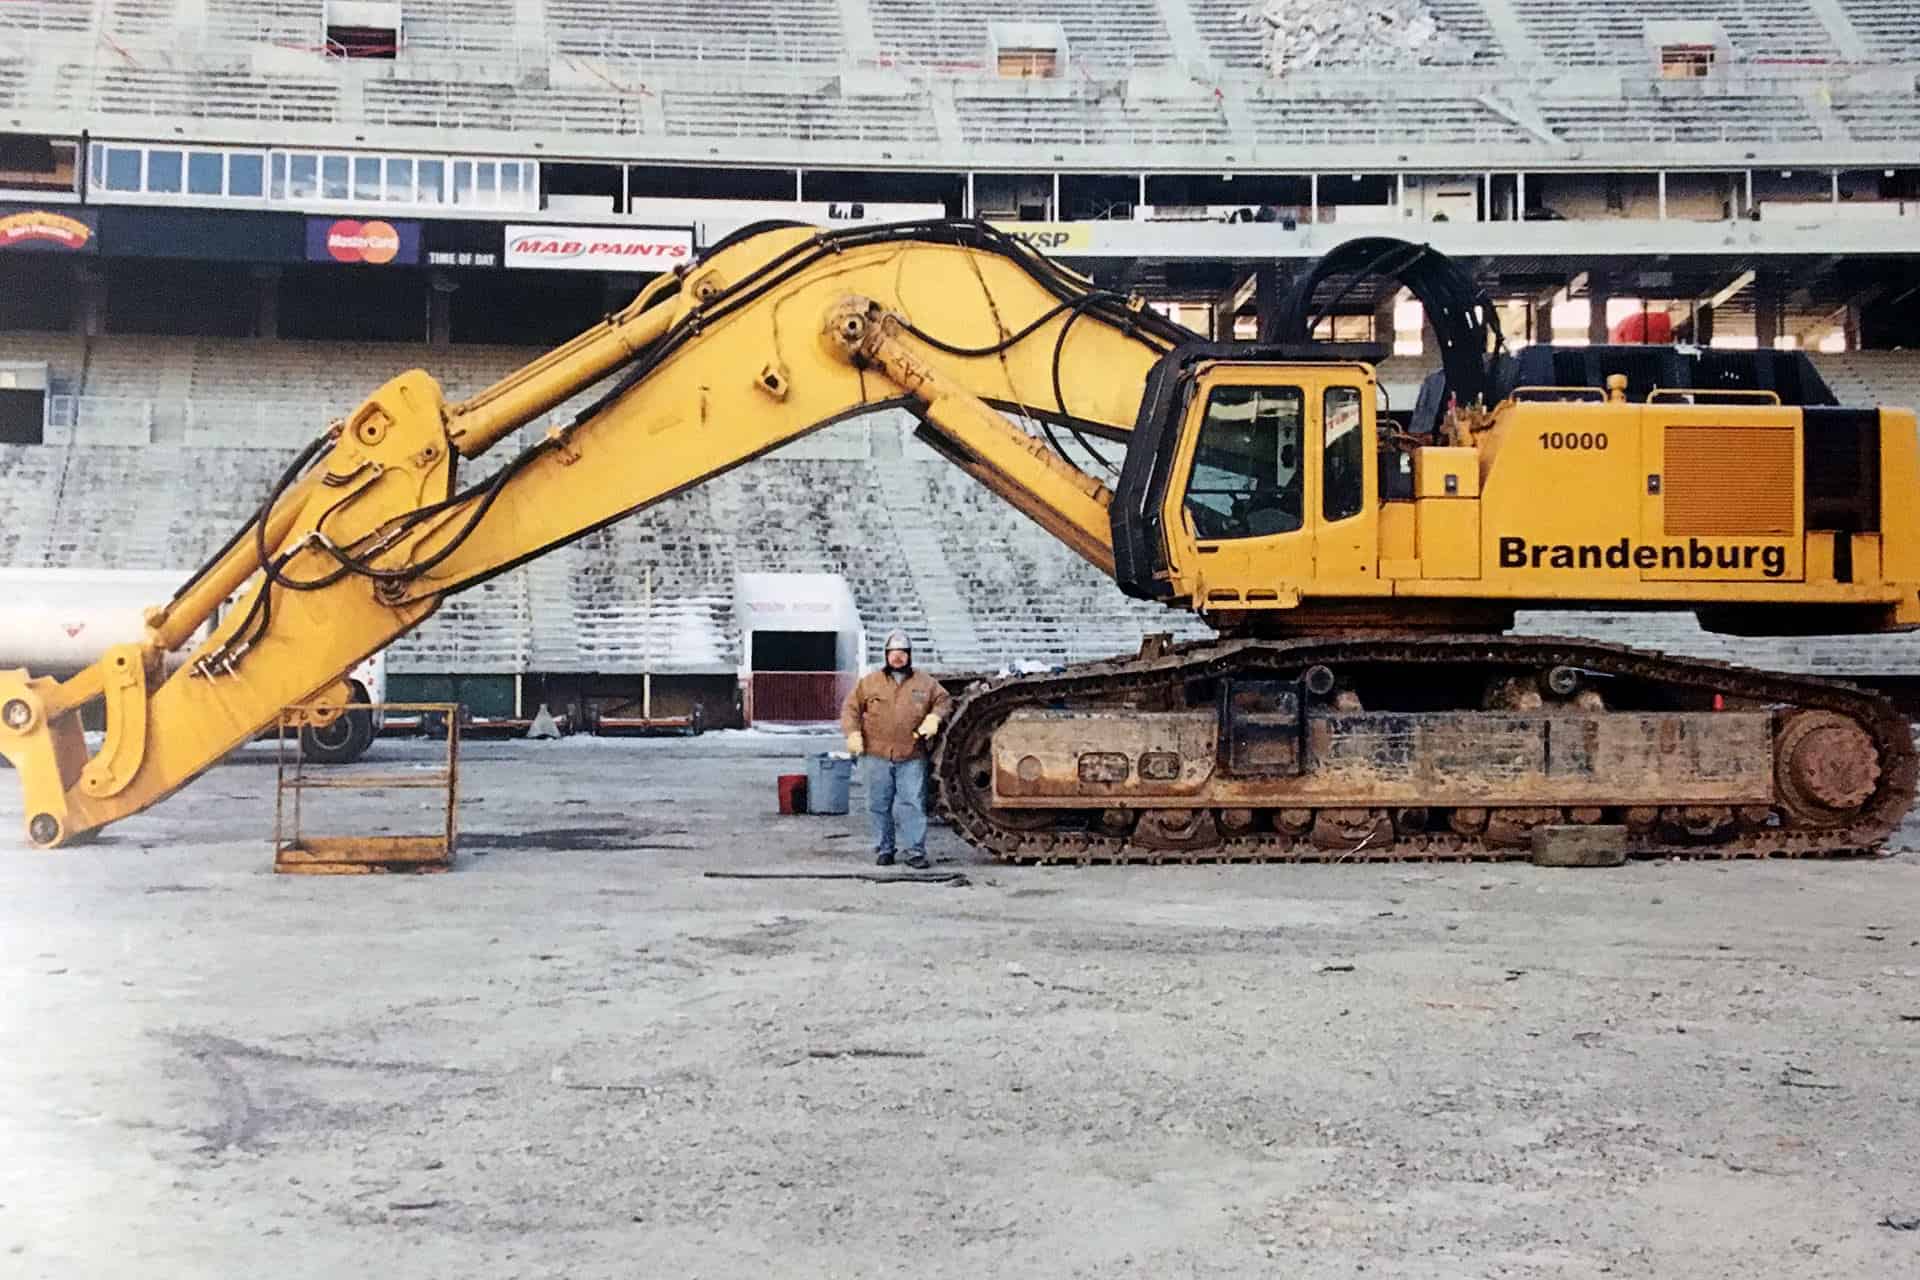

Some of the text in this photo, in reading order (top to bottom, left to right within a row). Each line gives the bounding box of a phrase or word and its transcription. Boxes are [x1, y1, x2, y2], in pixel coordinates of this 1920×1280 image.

[1010, 231, 1070, 248] YSP
[515, 240, 687, 258] MAB PAINTS
[429, 252, 496, 266] TIME OF DAY
[1538, 432, 1609, 450] 10000
[1499, 536, 1786, 577] Brandenburg
